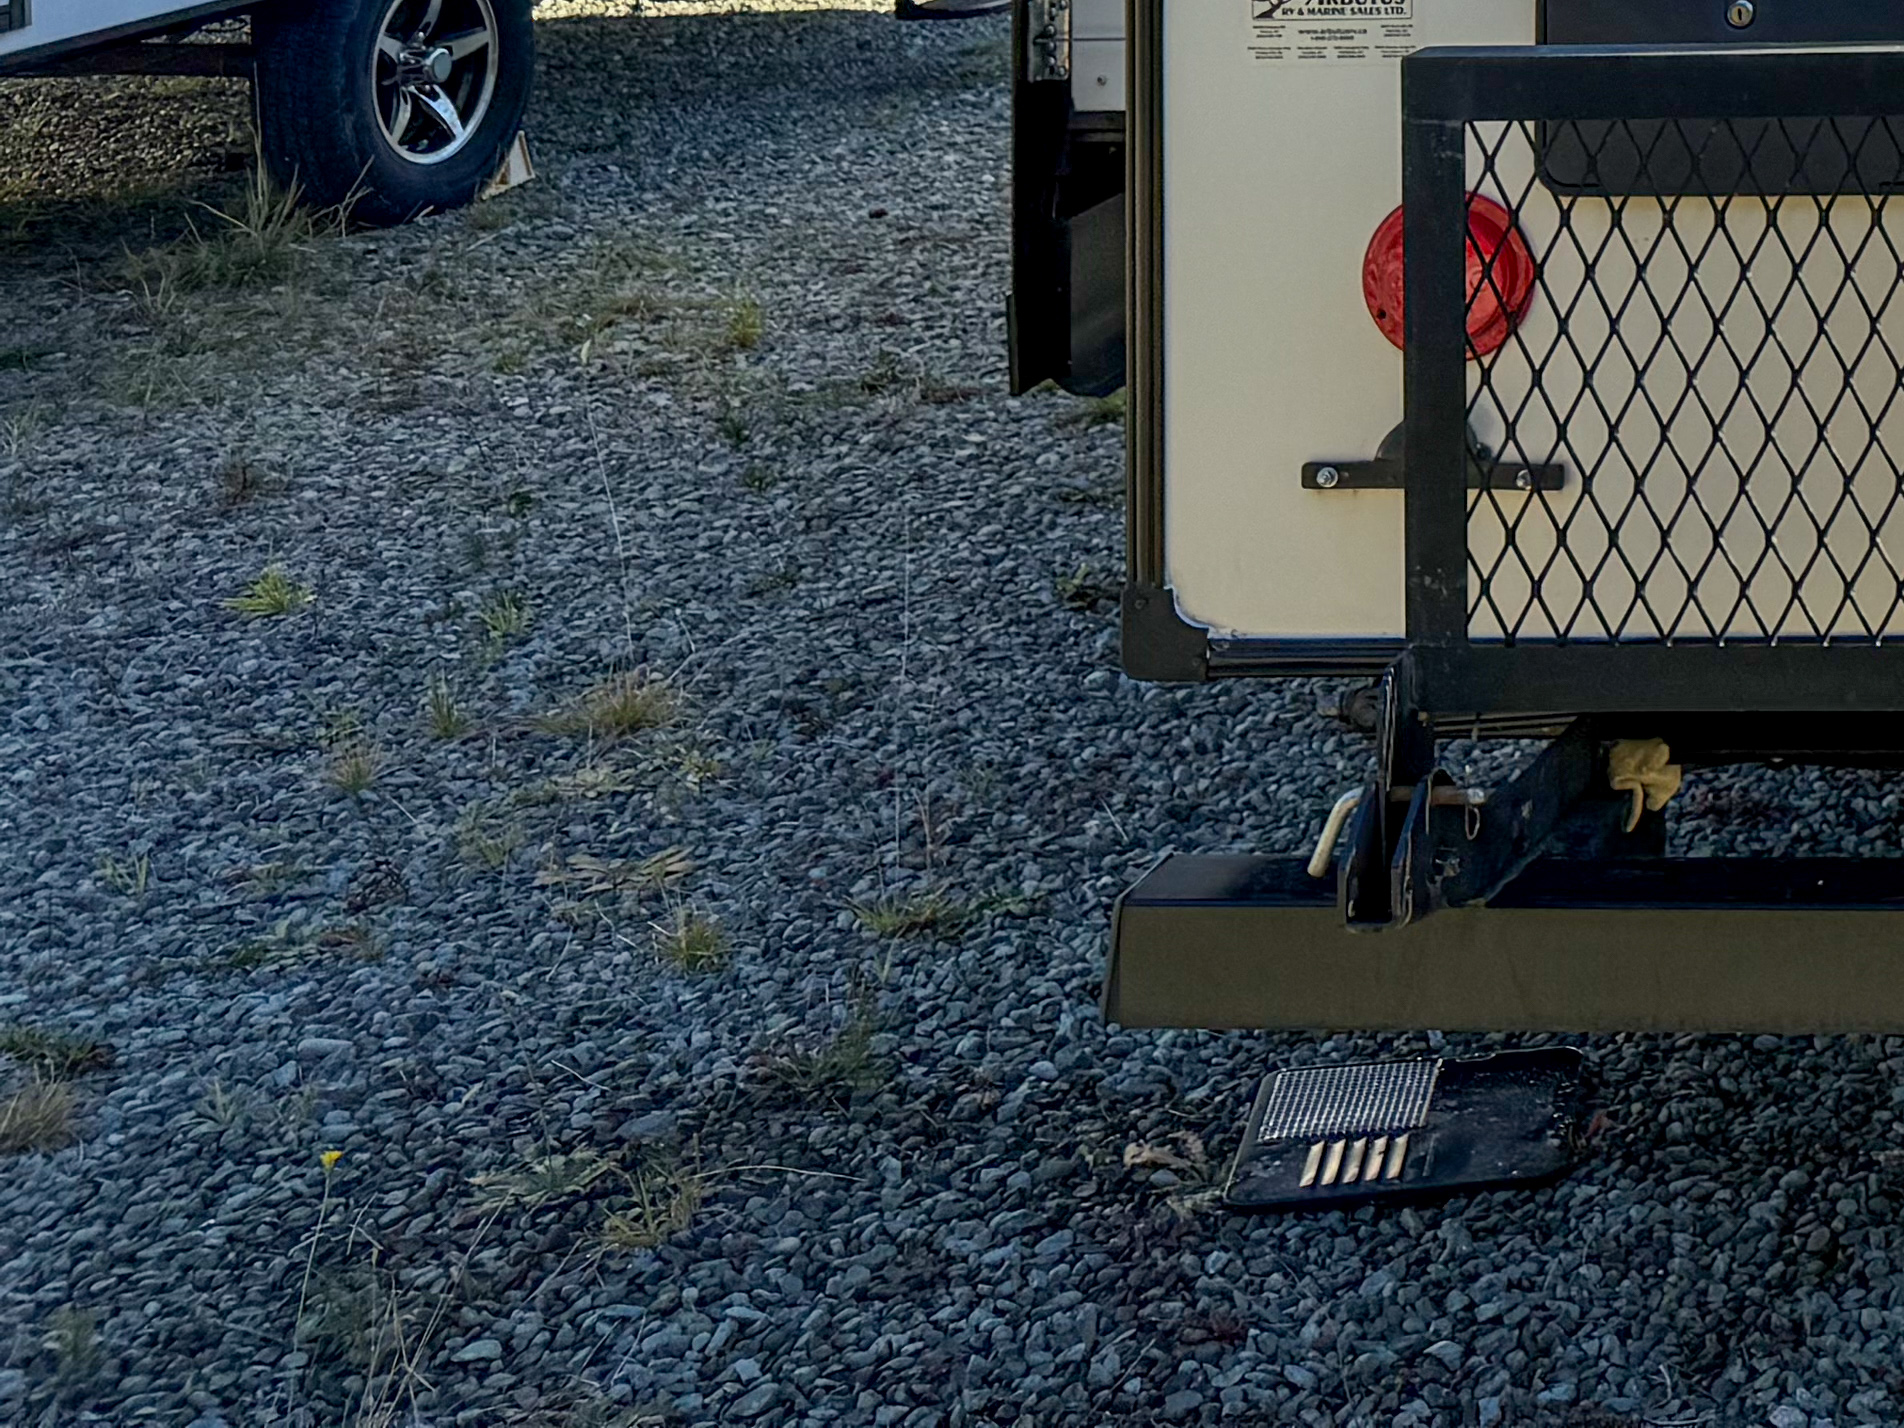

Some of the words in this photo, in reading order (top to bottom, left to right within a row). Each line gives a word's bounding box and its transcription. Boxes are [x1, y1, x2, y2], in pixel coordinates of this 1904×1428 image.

[1281, 7, 1295, 16] RV
[1307, 7, 1346, 16] MARINE
[1350, 6, 1382, 15] SALES
[1384, 6, 1407, 15] LTD.
